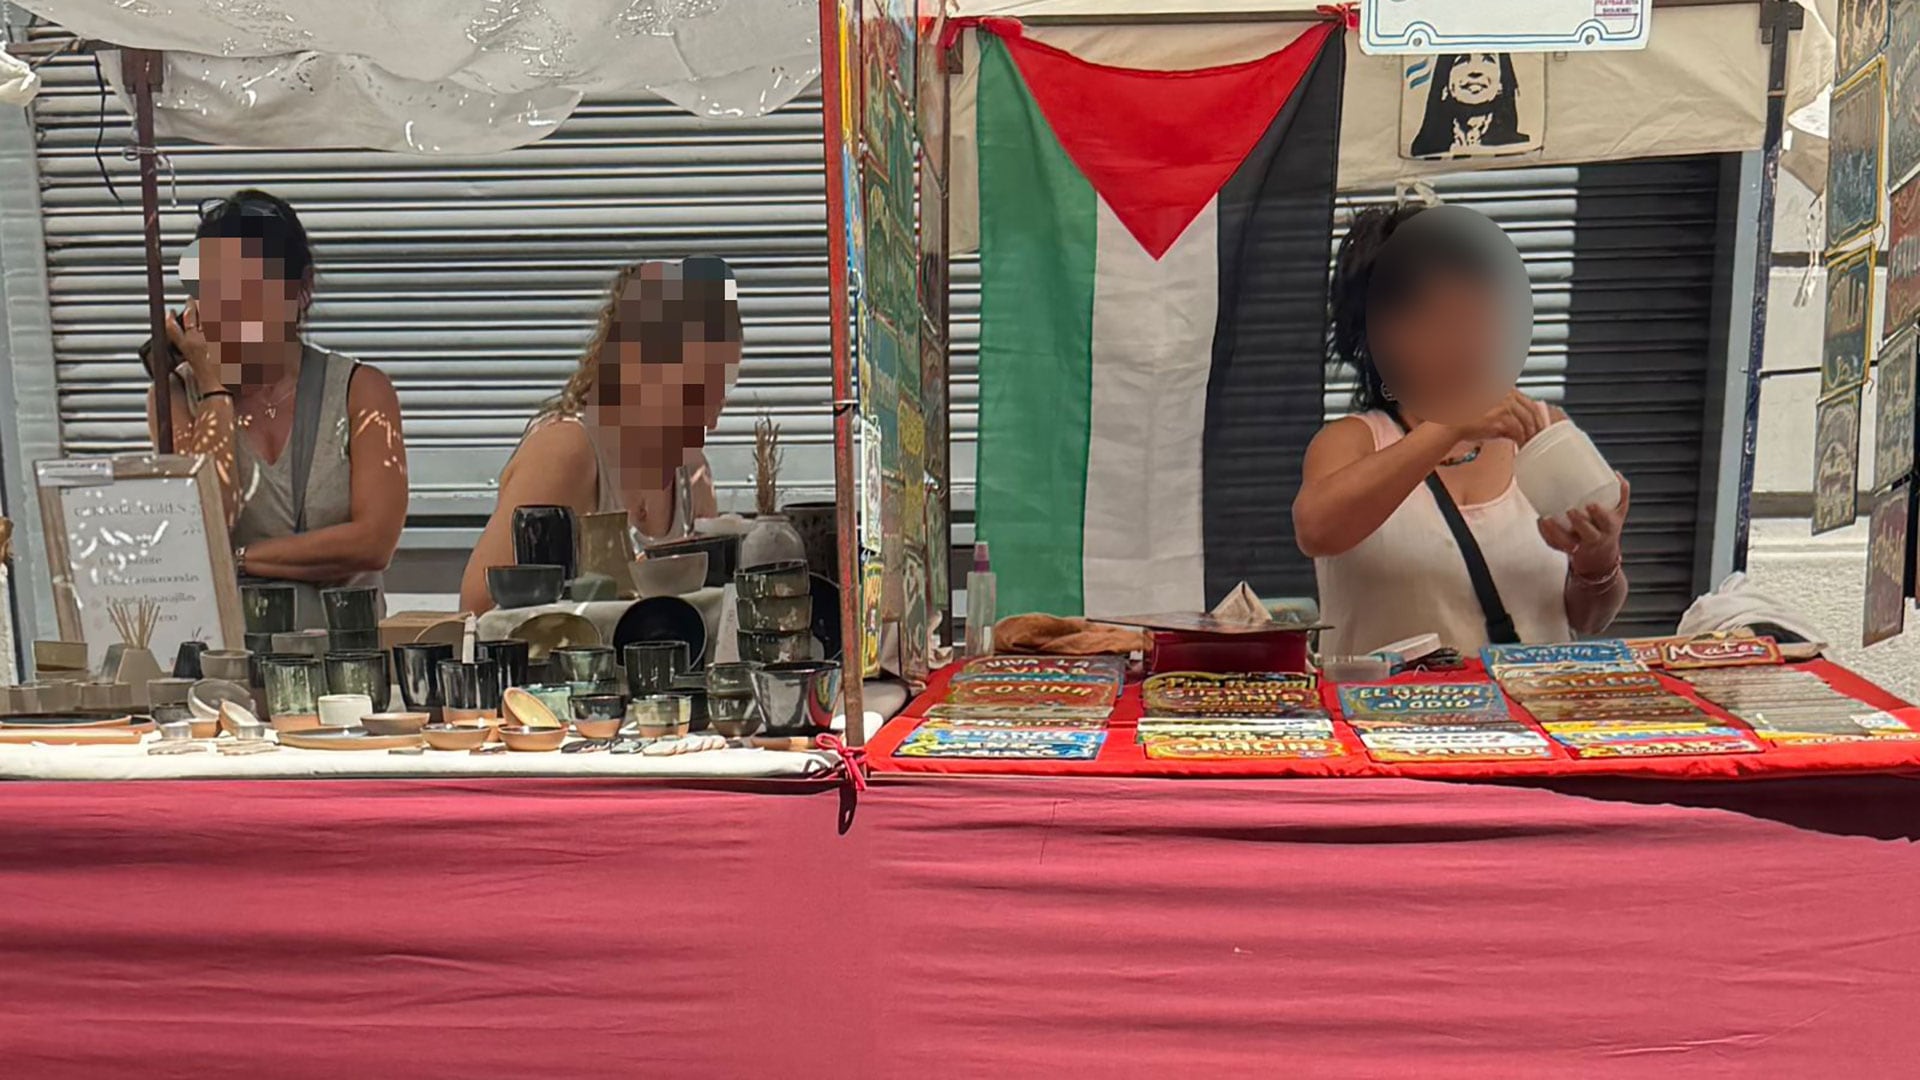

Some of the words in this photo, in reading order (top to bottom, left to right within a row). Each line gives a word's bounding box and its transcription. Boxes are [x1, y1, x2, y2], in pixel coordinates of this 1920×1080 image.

[974, 684, 1093, 697] COCINA
[1360, 687, 1385, 698] EL
[1392, 685, 1480, 696] AMOR
[1408, 699, 1471, 709] ODIO
[1175, 739, 1327, 750] GRACIAS
